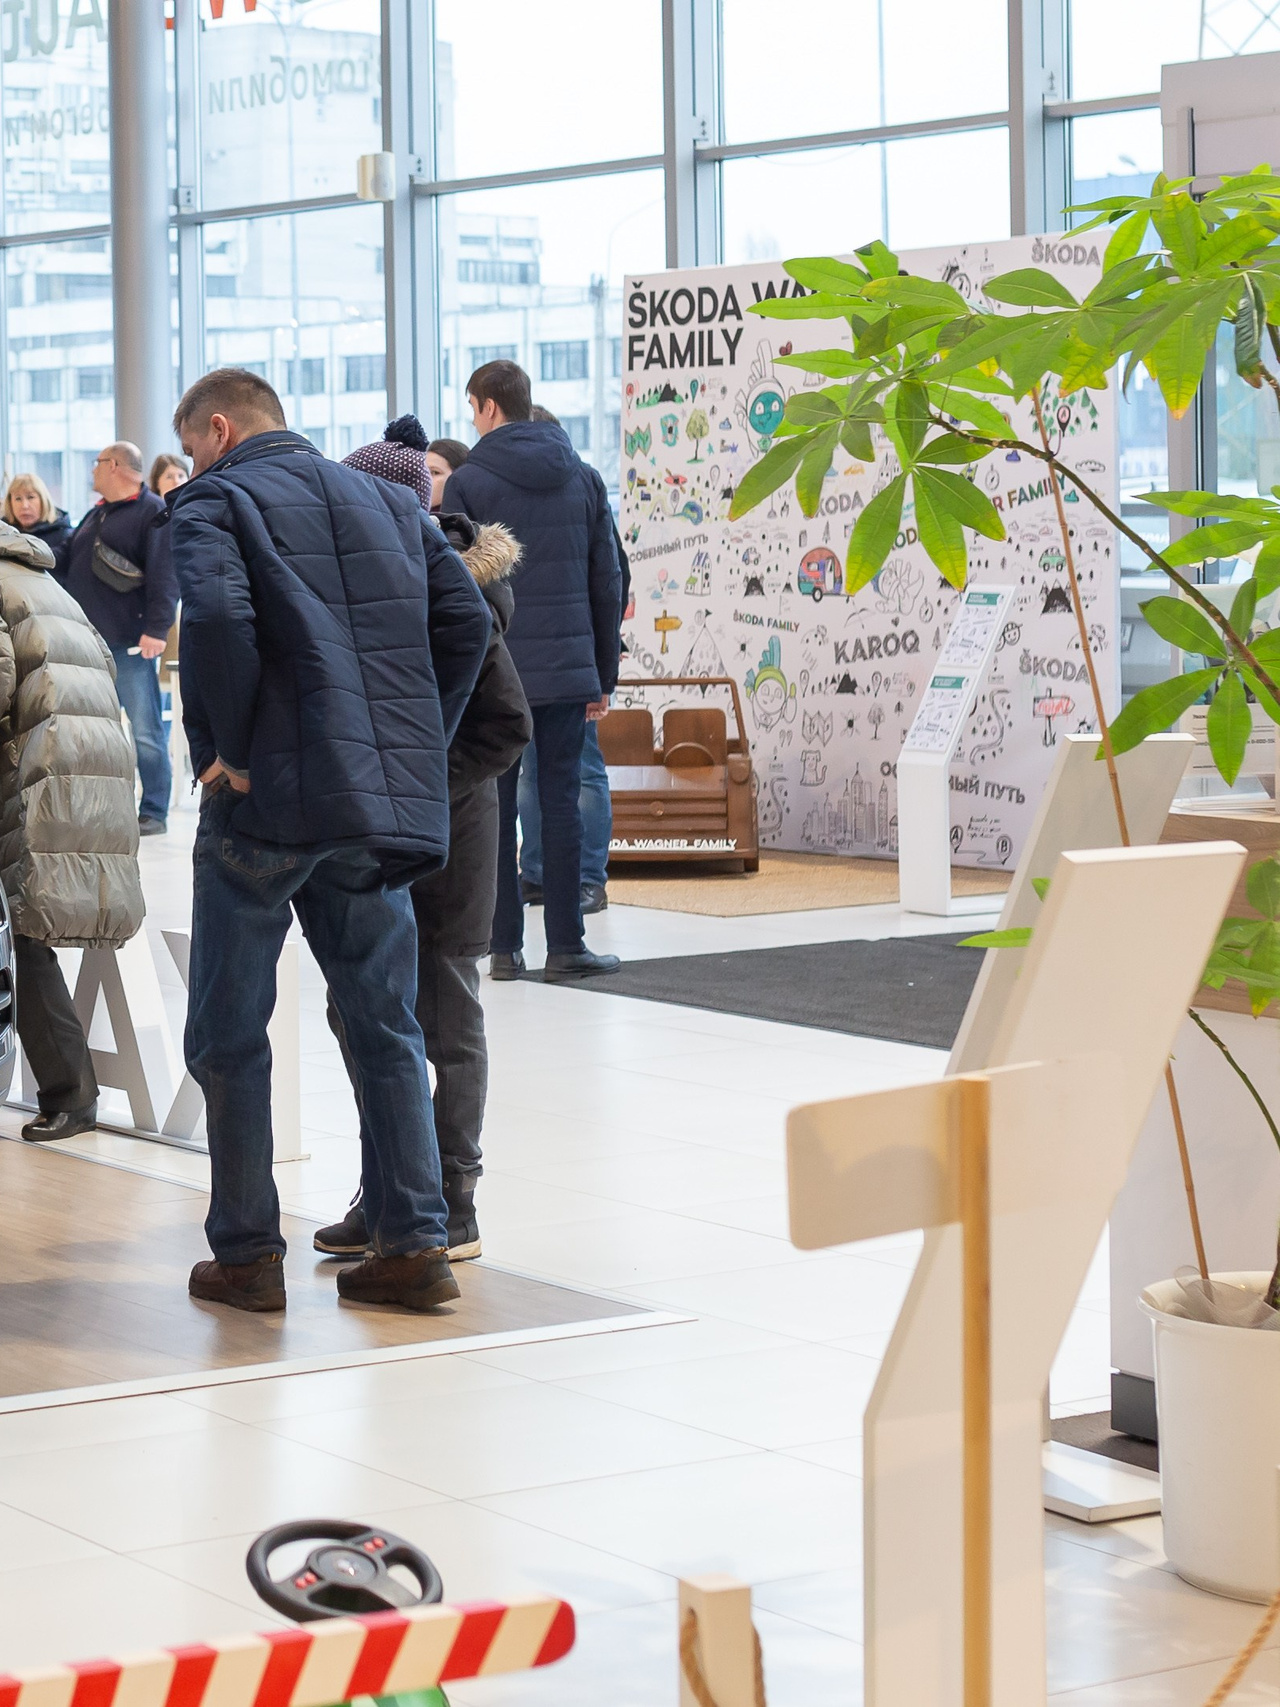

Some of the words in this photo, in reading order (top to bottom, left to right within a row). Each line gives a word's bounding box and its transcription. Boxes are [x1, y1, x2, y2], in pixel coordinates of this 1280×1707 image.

[1031, 237, 1101, 266] ŠKODA
[628, 281, 743, 328] ŠKODA
[628, 327, 743, 371] FAMILY
[815, 490, 865, 518] KODA
[1007, 474, 1065, 508] FAMILY
[628, 539, 682, 564] СОБЕННЫЙ
[683, 533, 709, 549] ПУТЬ
[733, 609, 765, 627] ŠKODA
[767, 617, 800, 633] FAMILY
[834, 629, 920, 665] KAROQ
[1019, 648, 1090, 685] ŠKODA
[984, 781, 1026, 805] ПУТЬ
